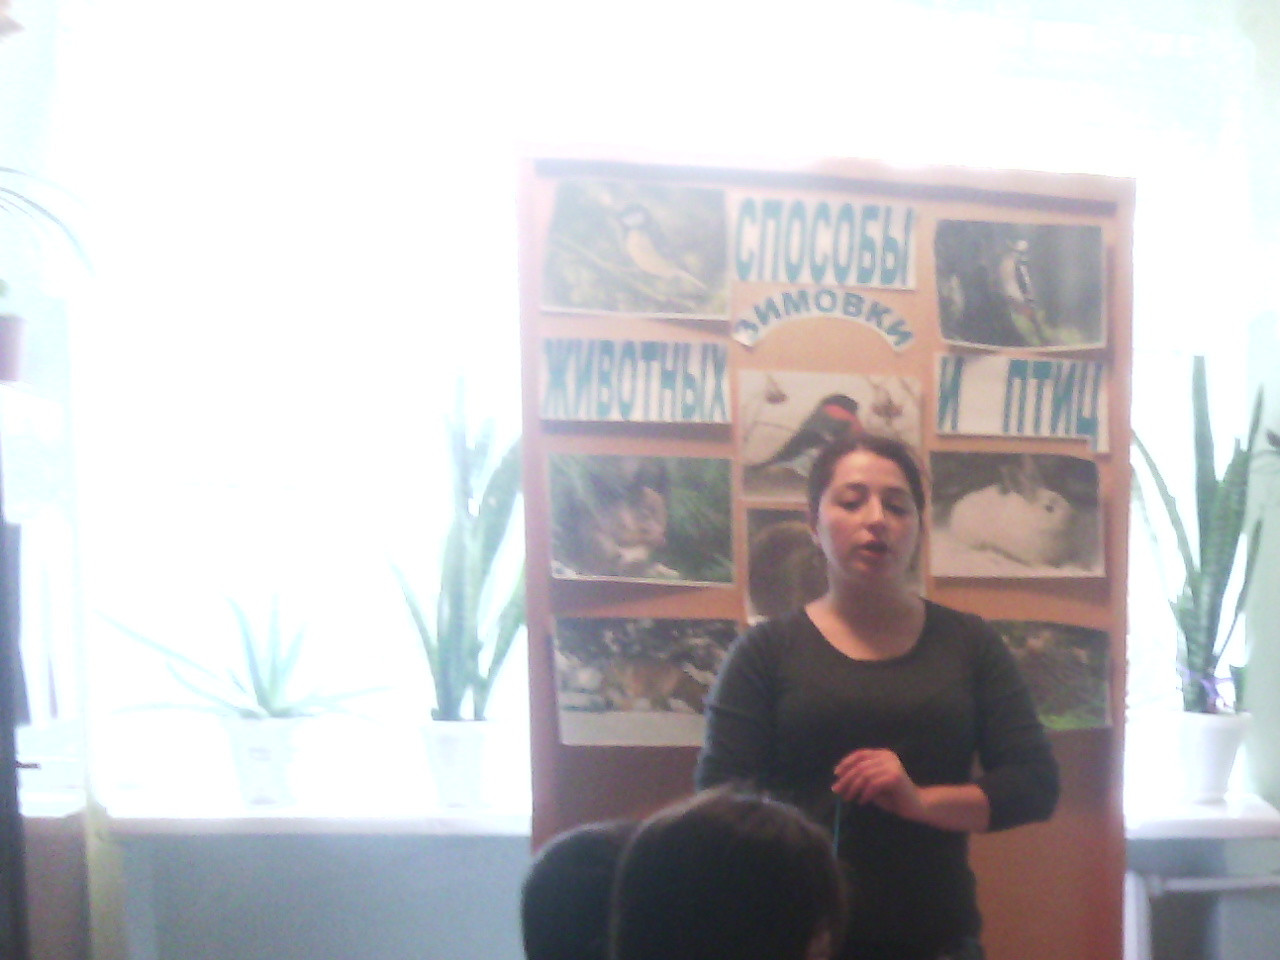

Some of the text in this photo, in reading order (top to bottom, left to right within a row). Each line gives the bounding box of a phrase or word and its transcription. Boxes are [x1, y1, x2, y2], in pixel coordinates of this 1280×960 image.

[736, 197, 913, 285] СПОСОБЫ
[734, 289, 913, 345] ЗИМОВКИ
[544, 338, 1103, 452] ЖИВОТНЫХ И ПТИЦ
